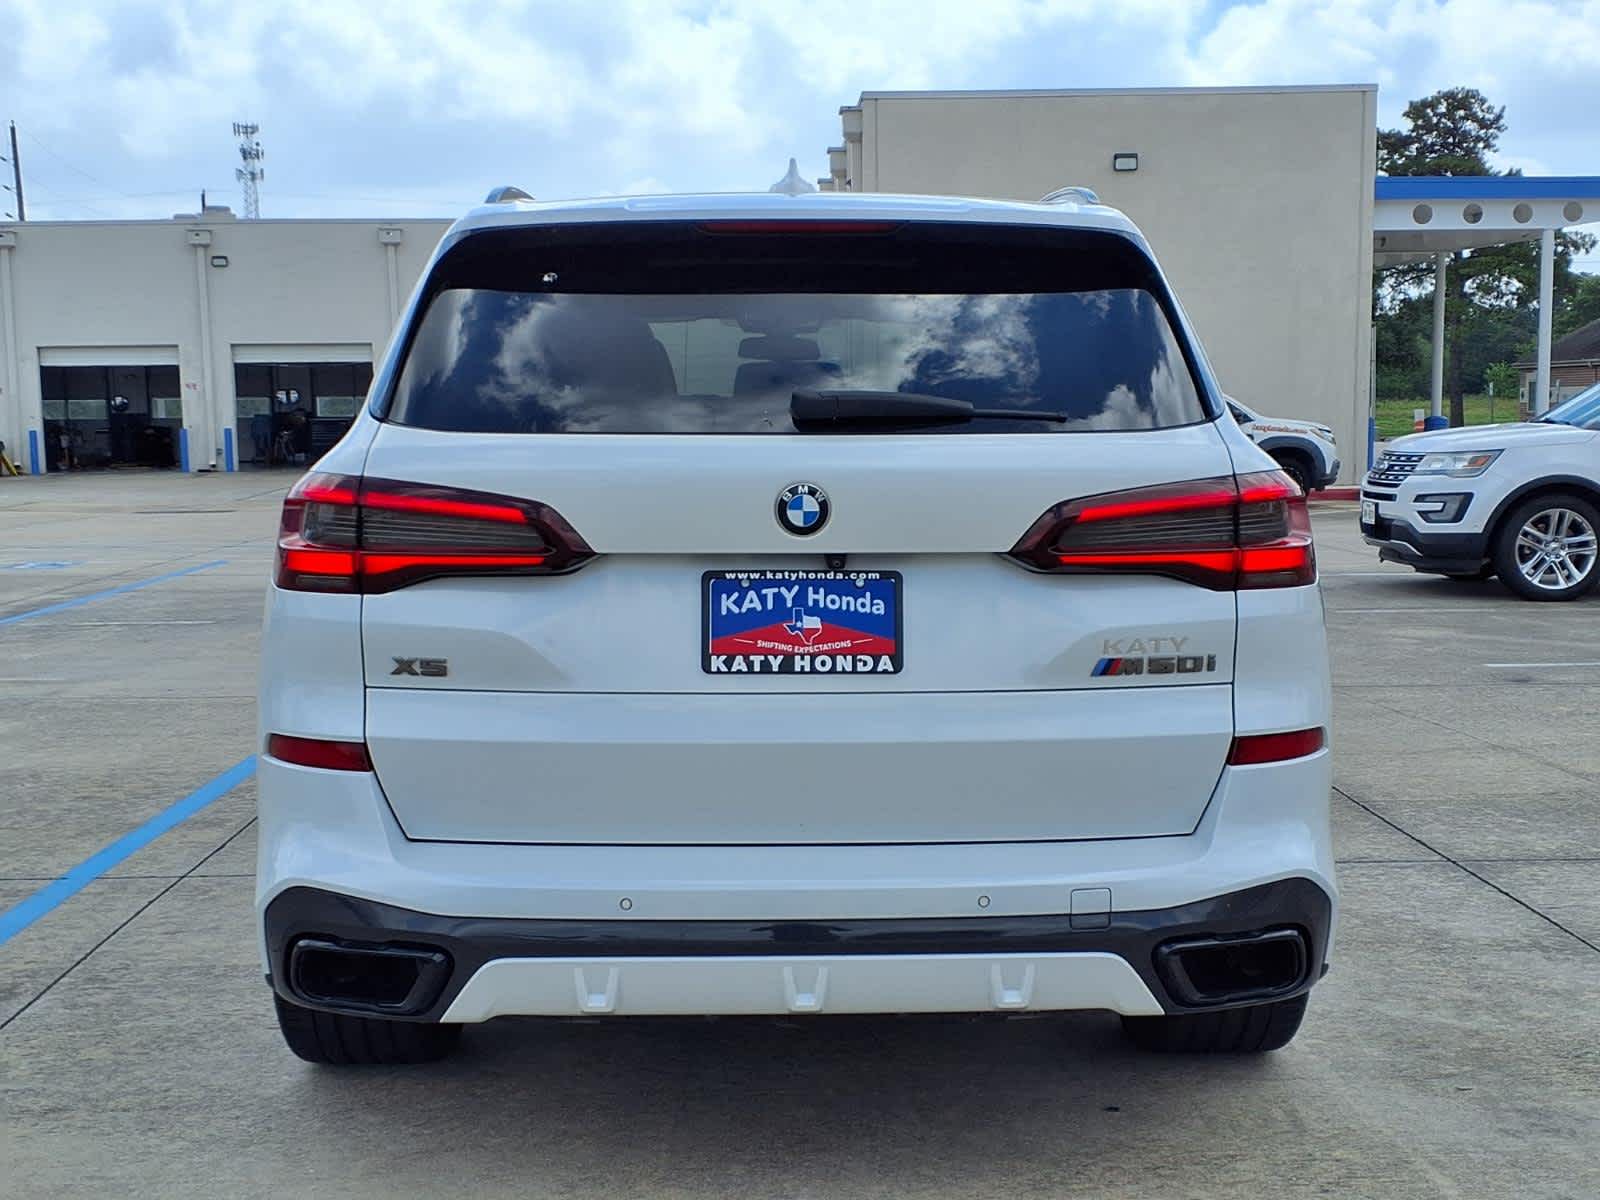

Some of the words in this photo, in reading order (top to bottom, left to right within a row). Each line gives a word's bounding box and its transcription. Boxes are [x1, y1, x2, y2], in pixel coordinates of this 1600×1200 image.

[782, 485, 826, 502] BMW
[725, 571, 880, 580] www.katyhonda.com
[720, 585, 799, 615] KATY
[807, 586, 886, 615] Honda
[756, 640, 793, 652] SHIFTING
[794, 640, 852, 654] EXPECTATIONS
[1103, 636, 1188, 655] KATY
[390, 656, 448, 677] X5
[710, 655, 784, 672] KATY
[794, 655, 894, 672] HONDA
